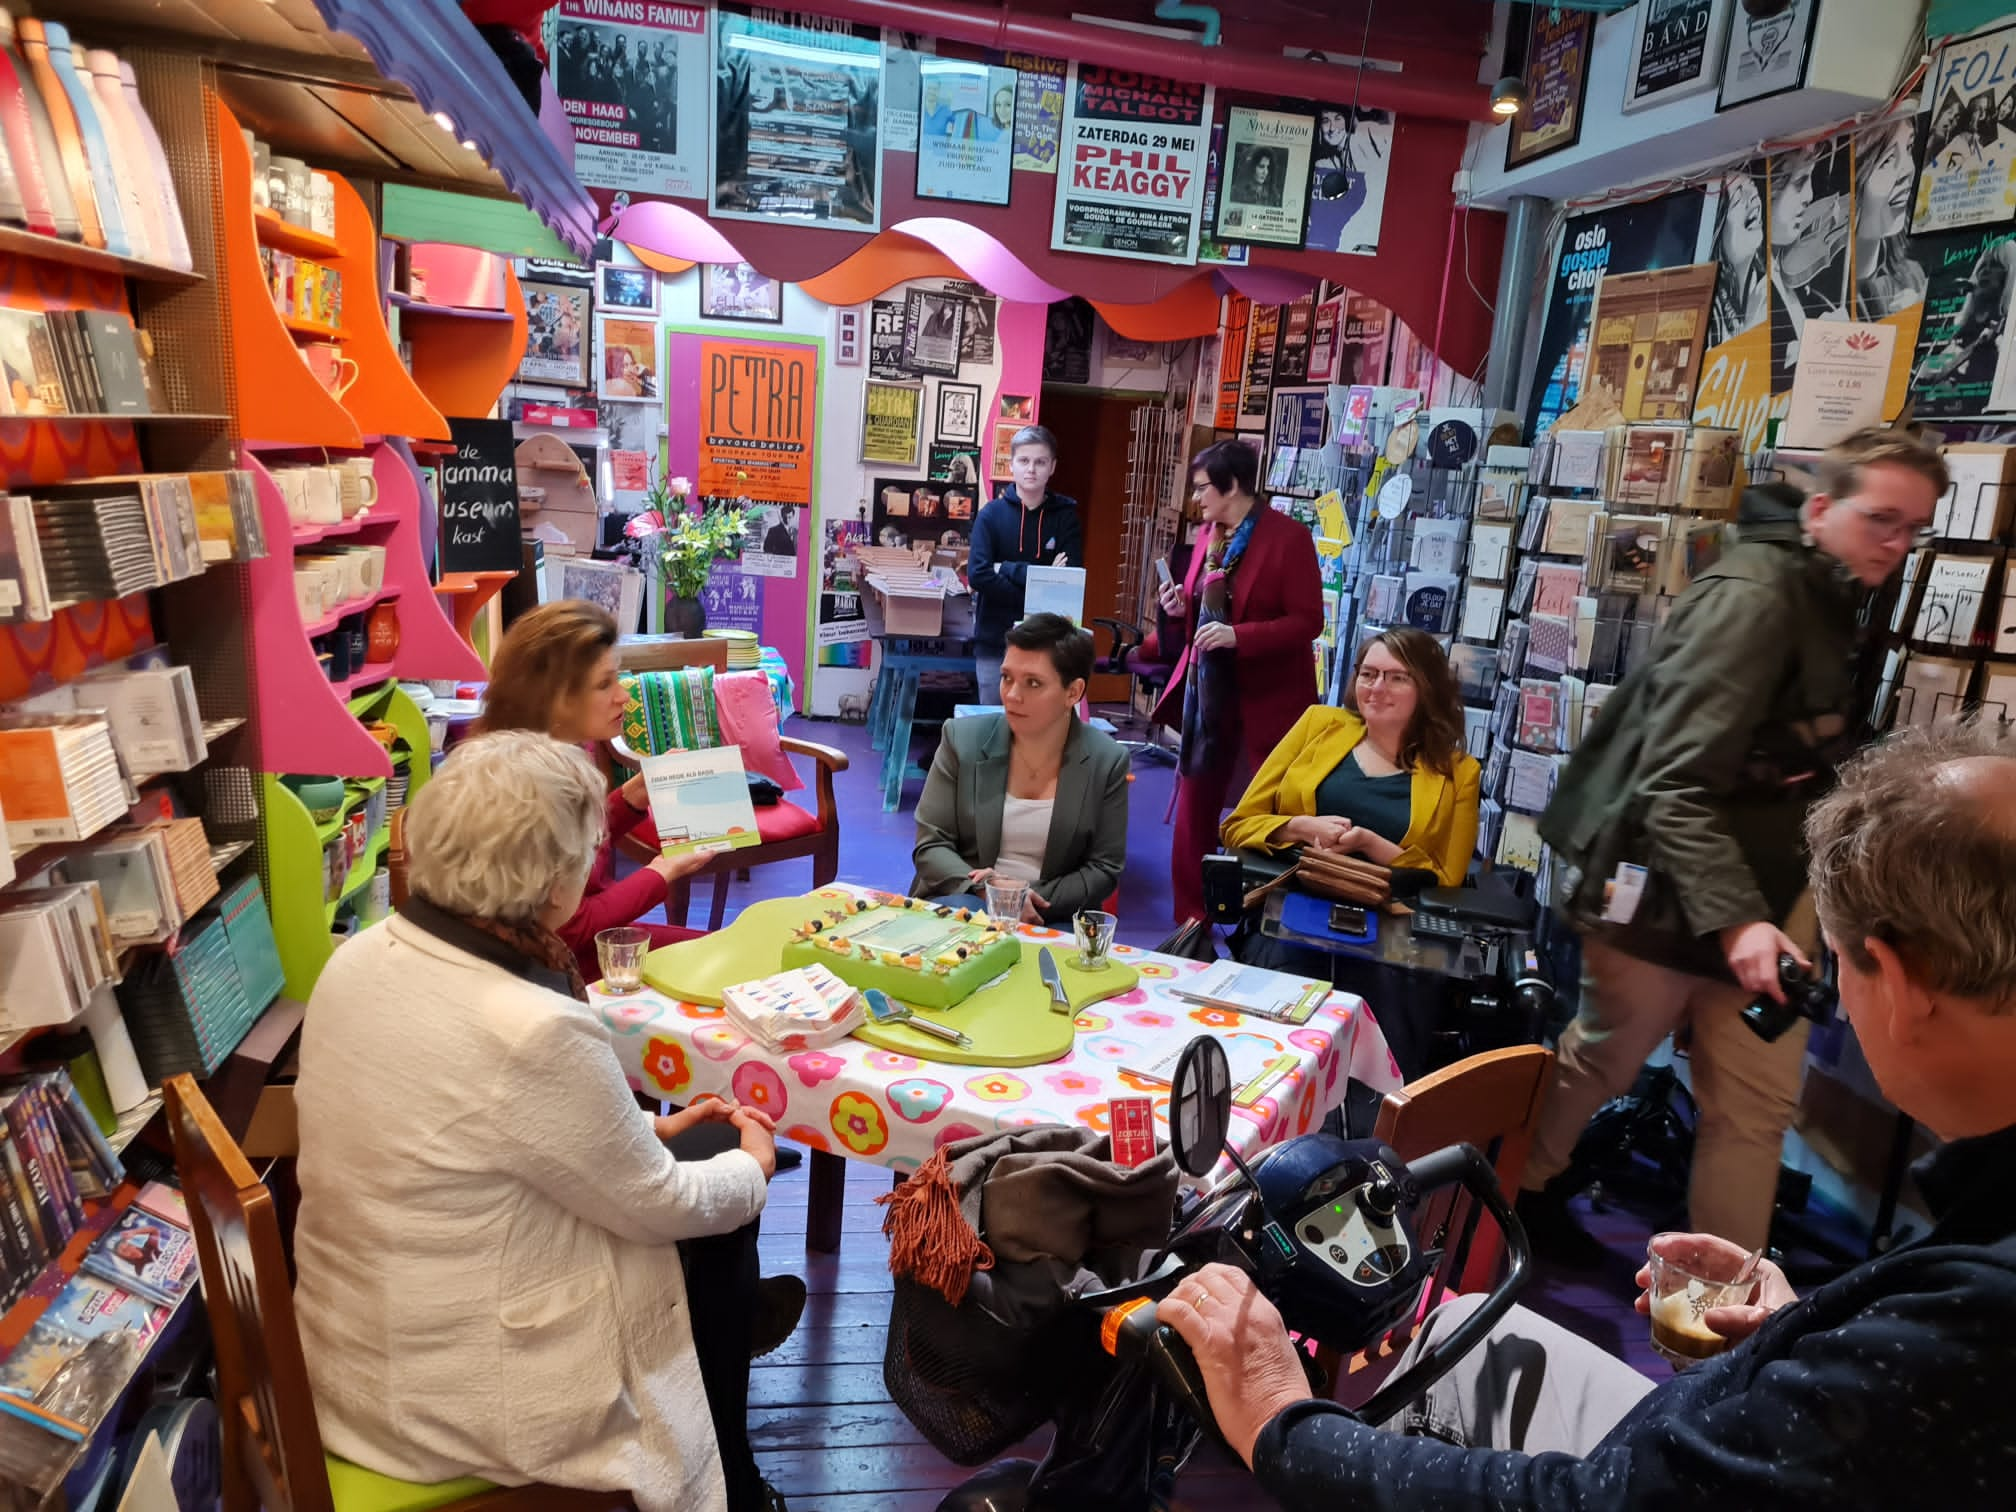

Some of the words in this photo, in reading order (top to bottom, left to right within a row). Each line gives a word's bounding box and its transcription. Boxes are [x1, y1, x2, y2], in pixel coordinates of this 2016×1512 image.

[584, 0, 645, 21] WINANS
[648, 5, 700, 28] FAMILY
[563, 100, 586, 113] DEN
[592, 105, 624, 119] HAAG
[1083, 85, 1198, 108] MICHAEL
[1083, 97, 1198, 121] TALBOT
[575, 127, 637, 145] NOVEMBER
[1078, 126, 1148, 145] ZATERDAG
[1152, 135, 1167, 148] 29
[1171, 136, 1195, 152] MEI
[1076, 144, 1191, 174] PHIL
[1073, 164, 1190, 200] KEAGGY
[1575, 224, 1606, 251] oslo
[1560, 241, 1611, 277] gospel
[1568, 263, 1607, 290] choir
[710, 353, 804, 439] PETRA
[459, 442, 481, 460] de
[452, 523, 486, 545] kast
